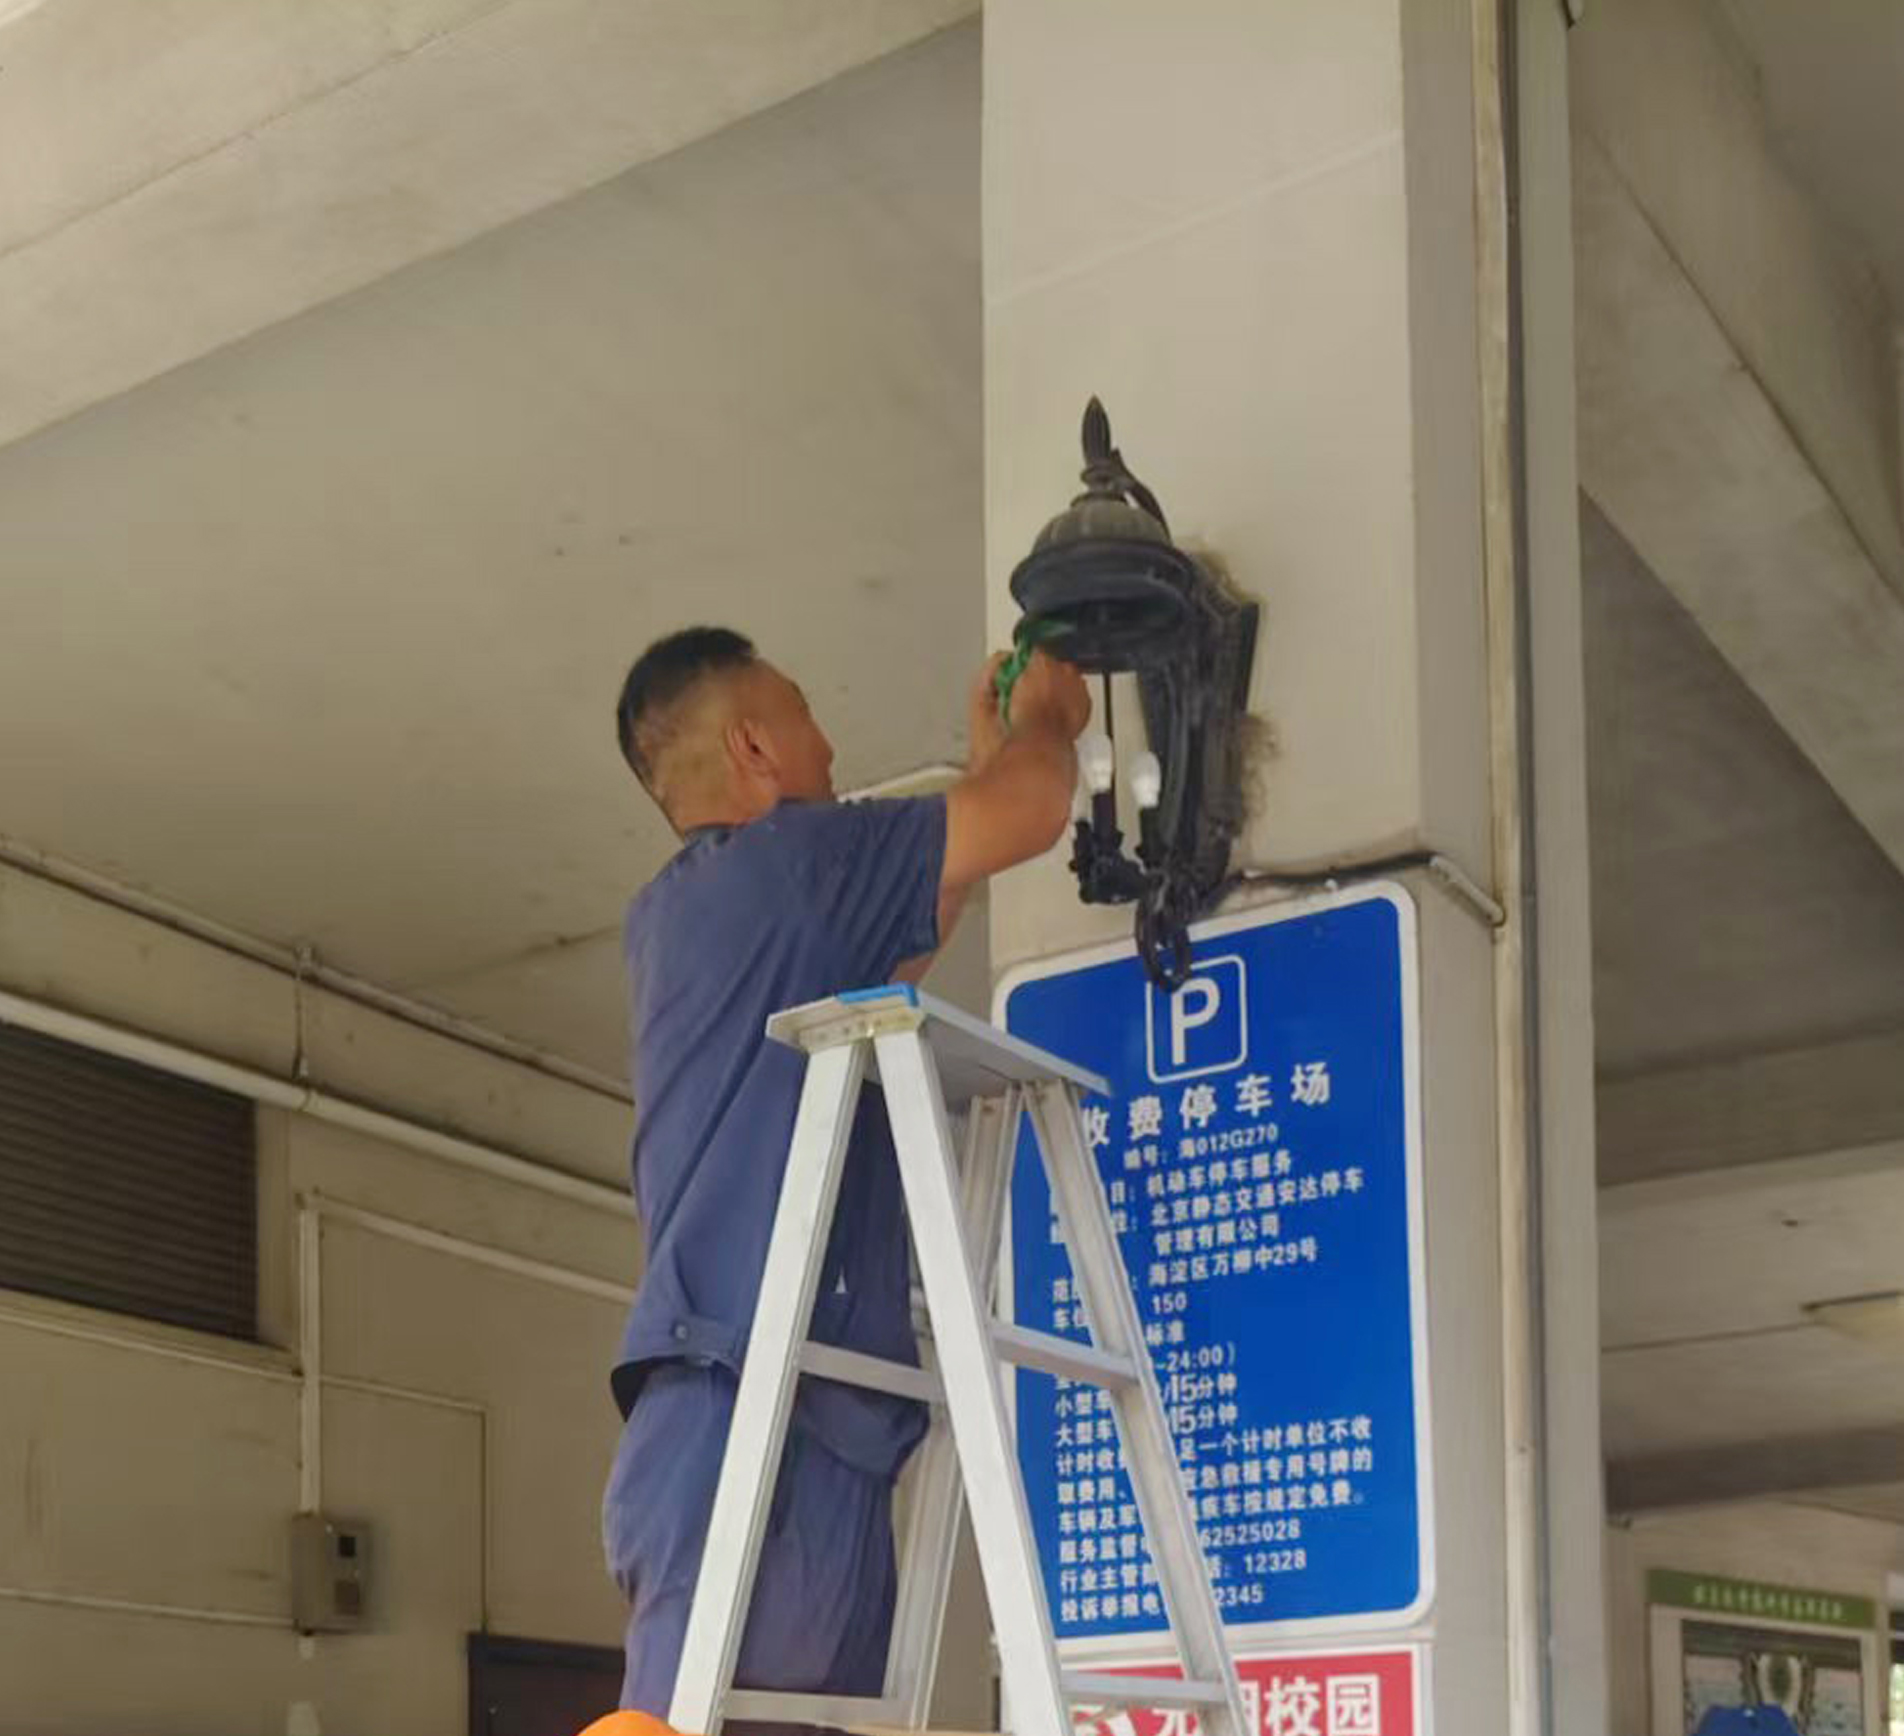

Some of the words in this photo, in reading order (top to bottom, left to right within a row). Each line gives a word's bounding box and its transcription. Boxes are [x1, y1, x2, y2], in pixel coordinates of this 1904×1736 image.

[1170, 977, 1221, 1066] P
[1082, 1062, 1331, 1148] 收费停车场
[1151, 1292, 1187, 1315] 150
[1056, 1448, 1128, 1477] 计时收
[1060, 1535, 1150, 1565] 服务监督
[1244, 1548, 1307, 1574] 12328
